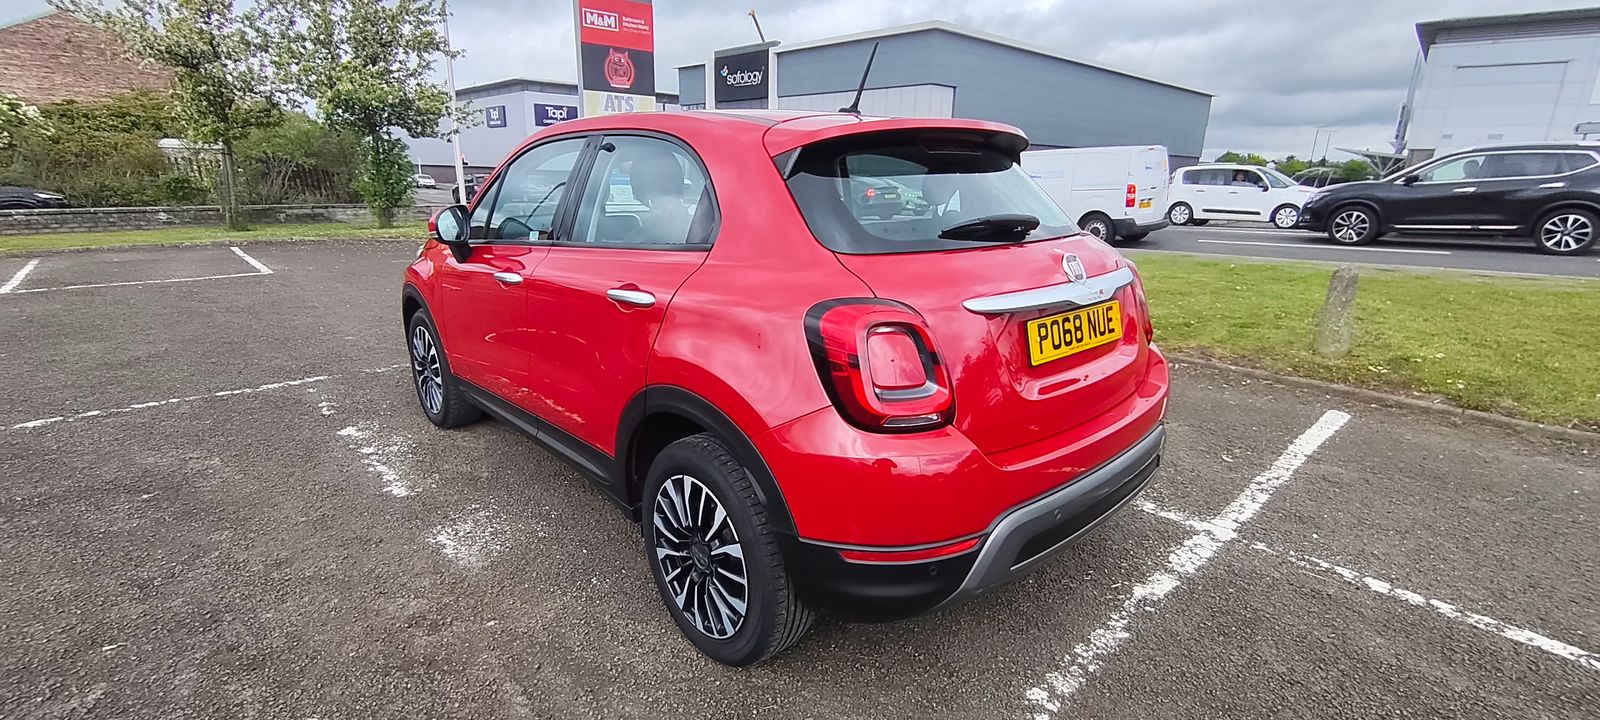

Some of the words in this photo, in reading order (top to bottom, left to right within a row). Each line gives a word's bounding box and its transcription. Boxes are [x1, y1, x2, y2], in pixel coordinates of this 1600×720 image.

[586, 12, 615, 28] M&M
[727, 70, 763, 85] sofology
[604, 95, 634, 112] ATS
[545, 106, 567, 120] Tapi
[1037, 314, 1083, 354] PO68
[1087, 306, 1115, 340] NUE
